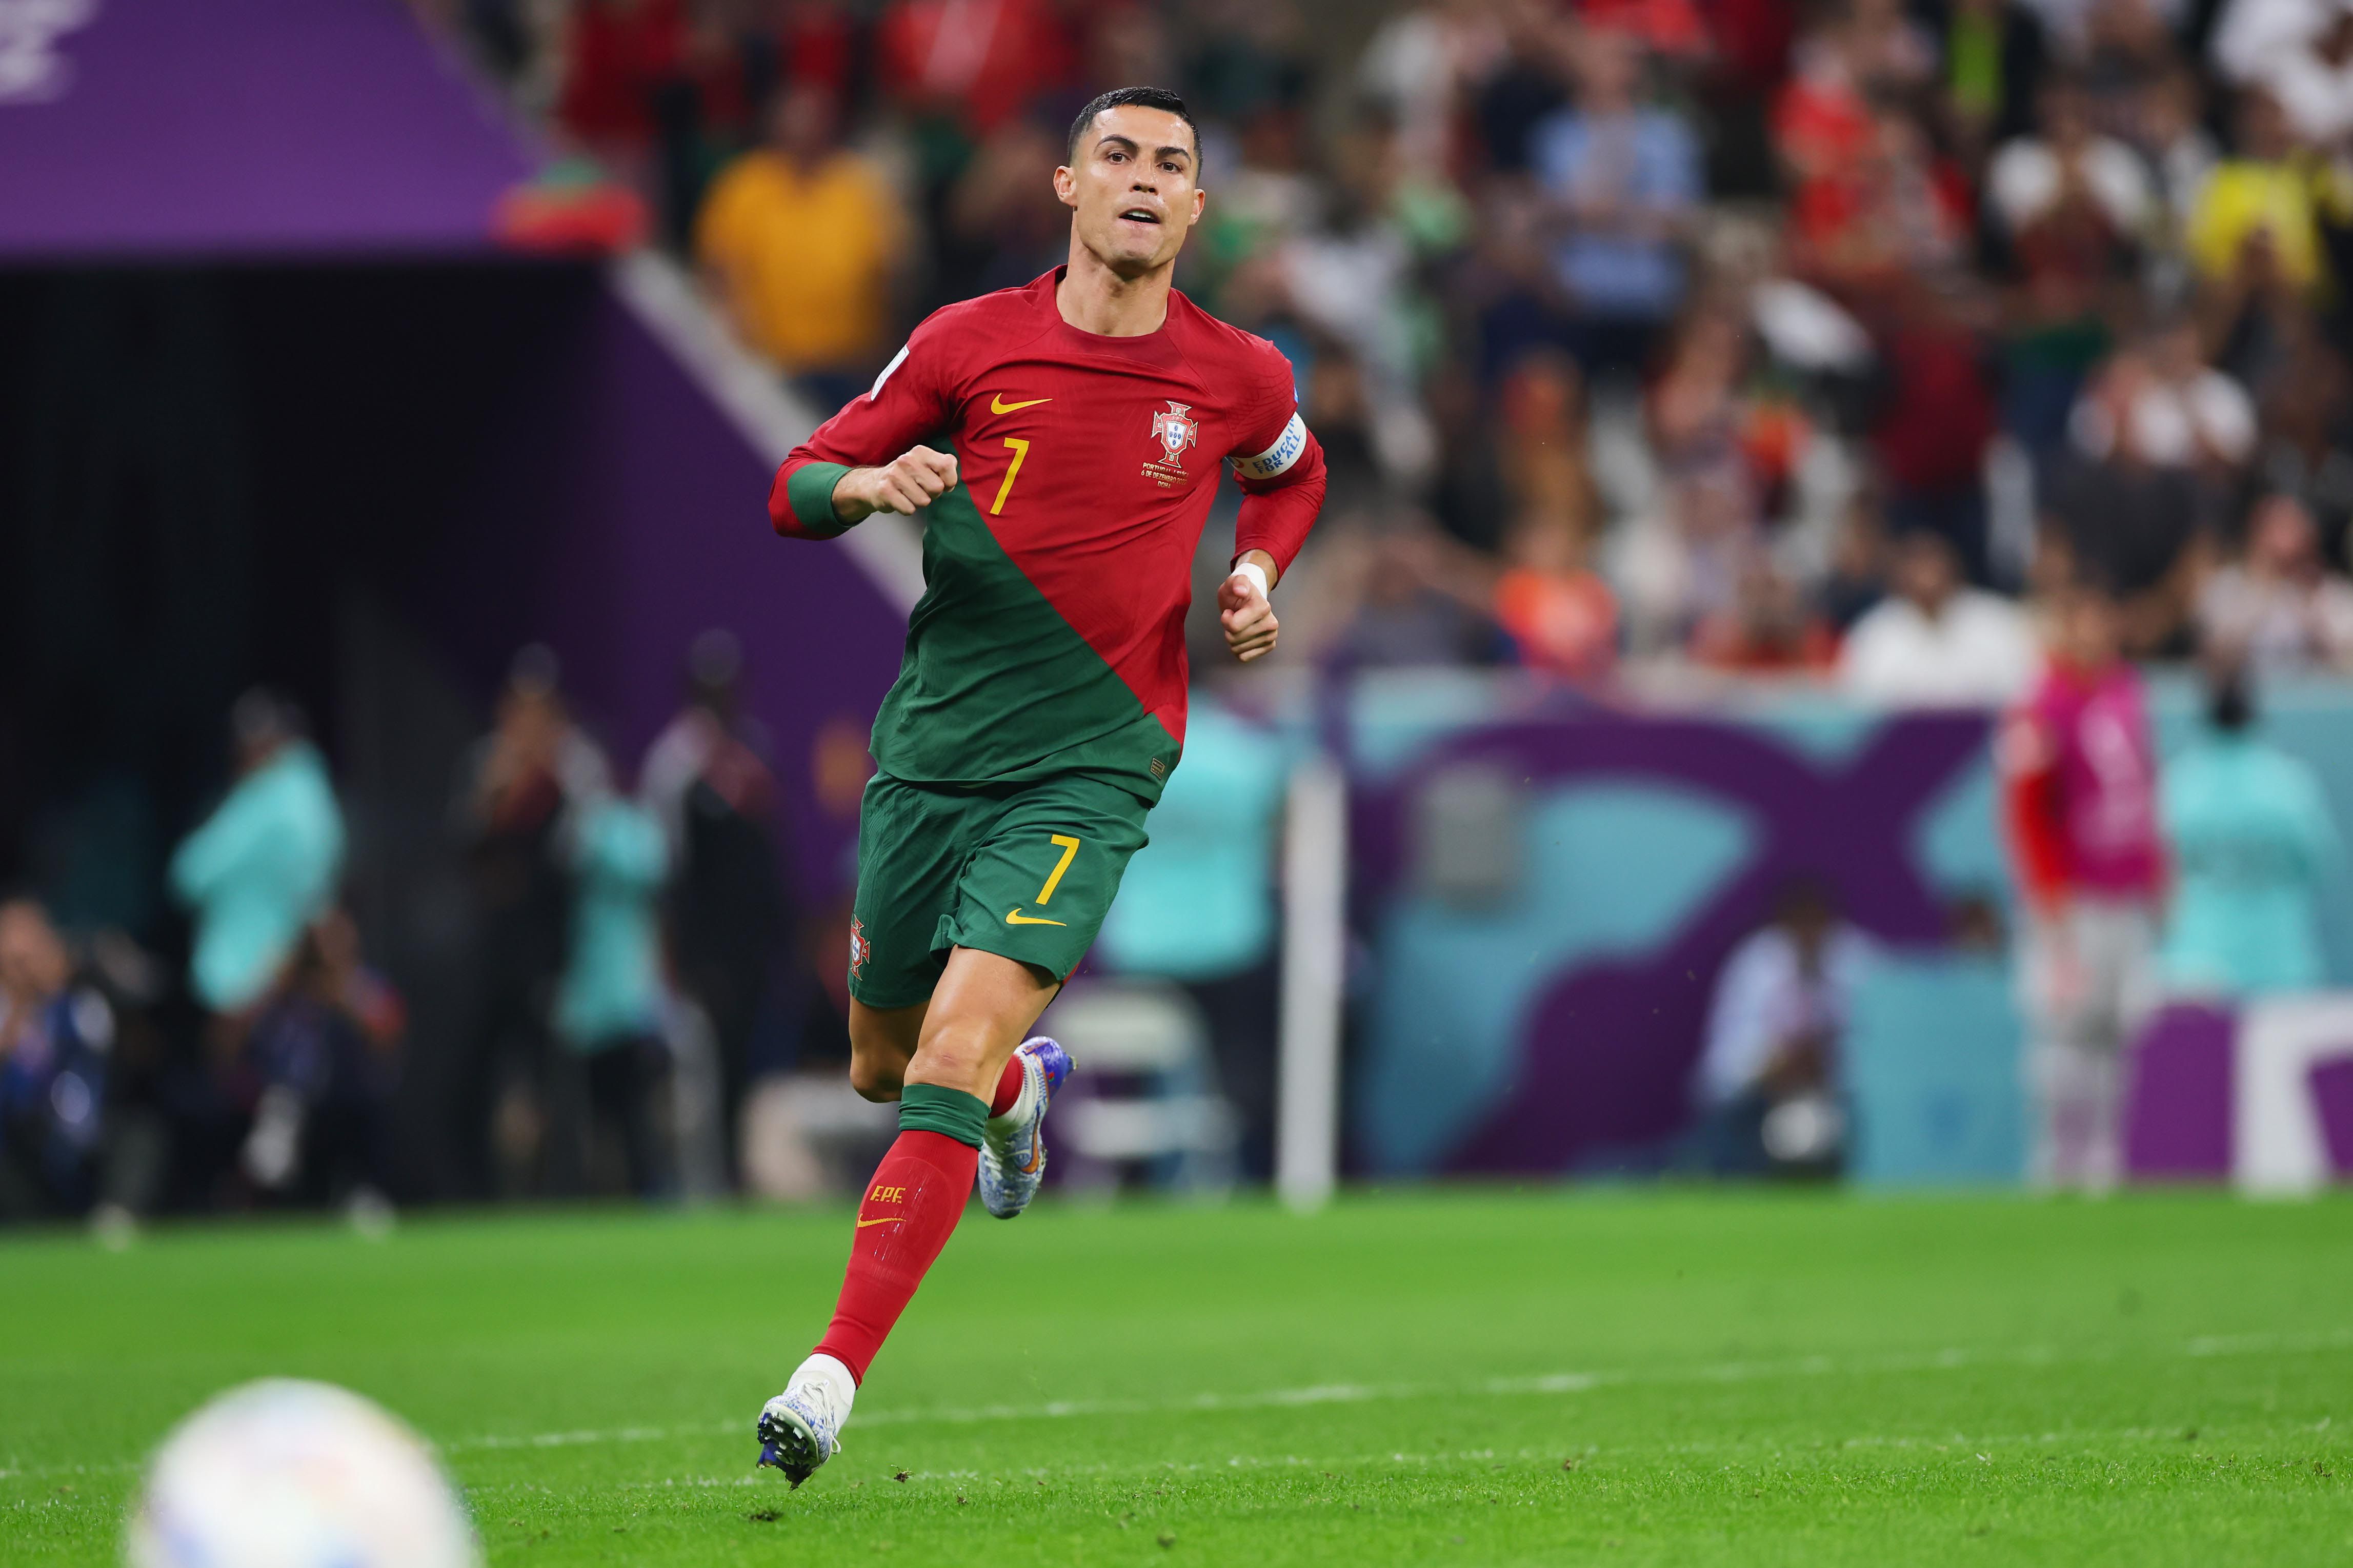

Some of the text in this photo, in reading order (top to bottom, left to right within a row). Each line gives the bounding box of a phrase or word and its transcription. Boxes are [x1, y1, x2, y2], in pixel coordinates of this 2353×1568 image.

[990, 437, 1030, 515] 7
[1153, 472, 1177, 483] DEZEMBRO
[1258, 435, 1301, 474] FOR ALL
[1035, 834, 1080, 905] 7
